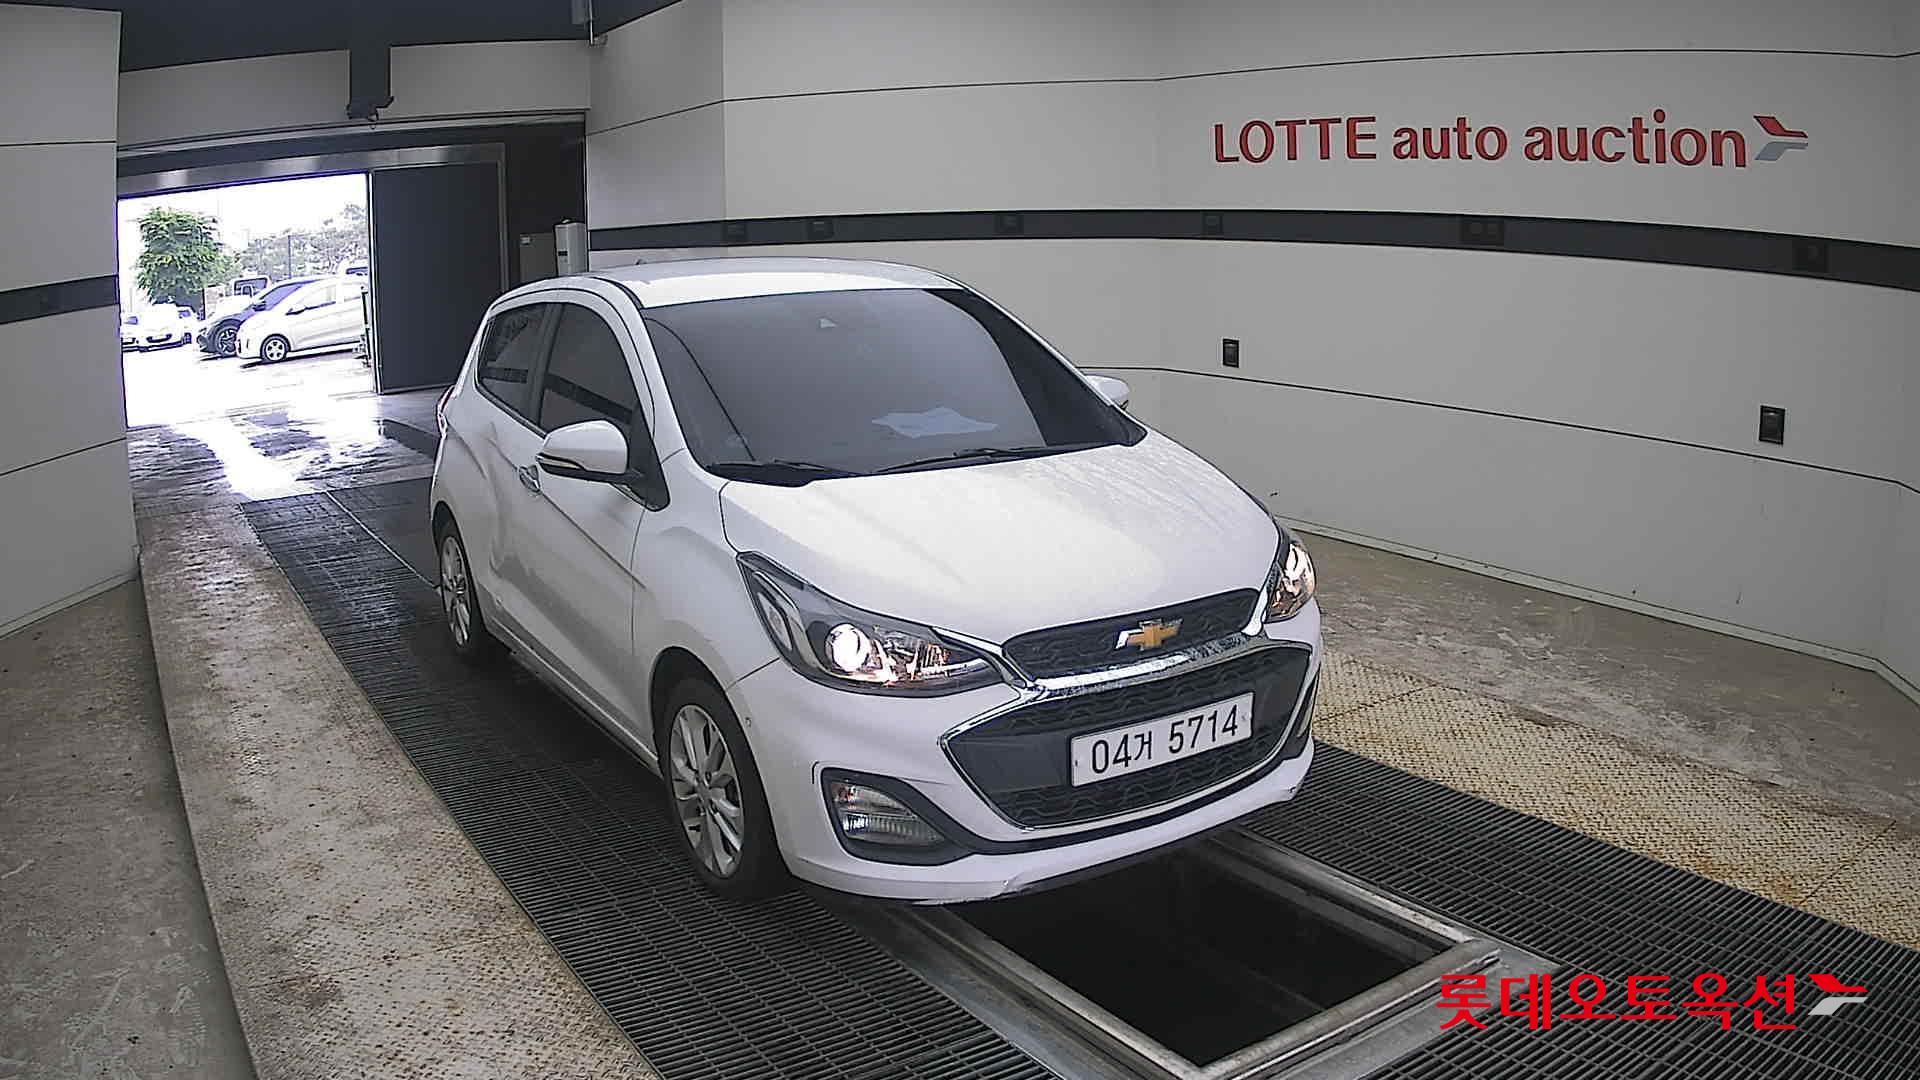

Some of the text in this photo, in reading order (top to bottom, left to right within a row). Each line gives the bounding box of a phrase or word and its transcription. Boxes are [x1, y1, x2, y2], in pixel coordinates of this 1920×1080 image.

[1215, 109, 1747, 168] LOTTE auto auction
[1091, 704, 1238, 774] 04거 5714
